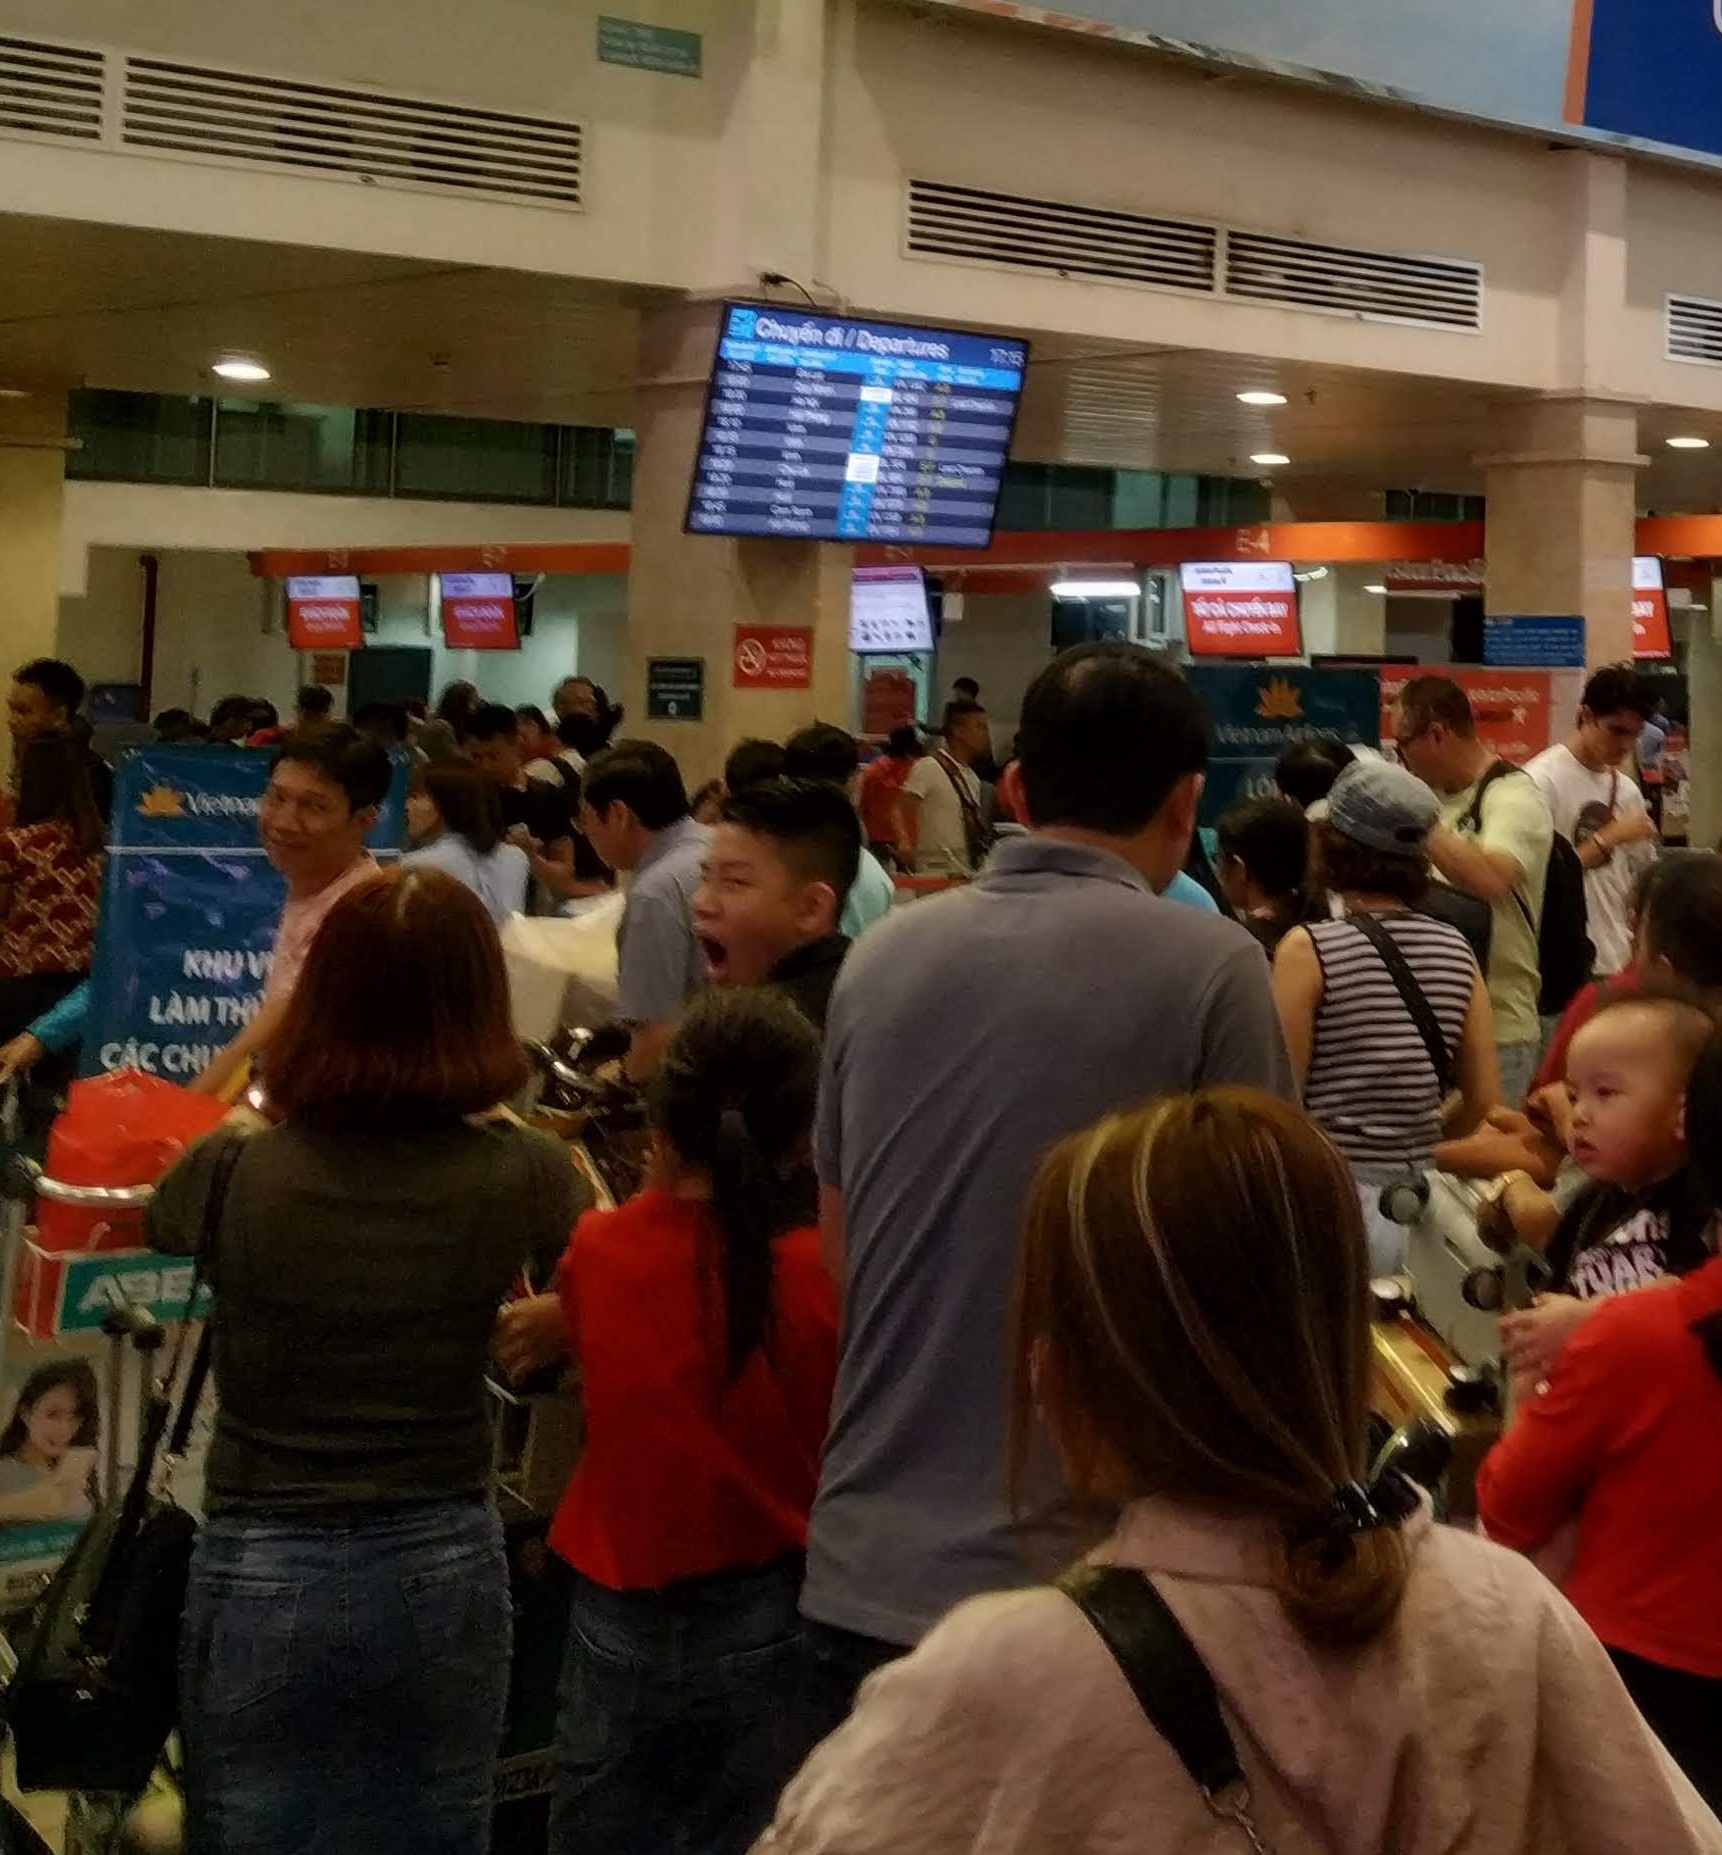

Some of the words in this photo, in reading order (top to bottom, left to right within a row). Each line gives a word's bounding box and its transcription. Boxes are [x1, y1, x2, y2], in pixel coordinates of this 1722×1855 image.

[755, 315, 823, 346] Chuyến
[857, 330, 949, 360] Departures
[150, 989, 211, 1025] LÀM
